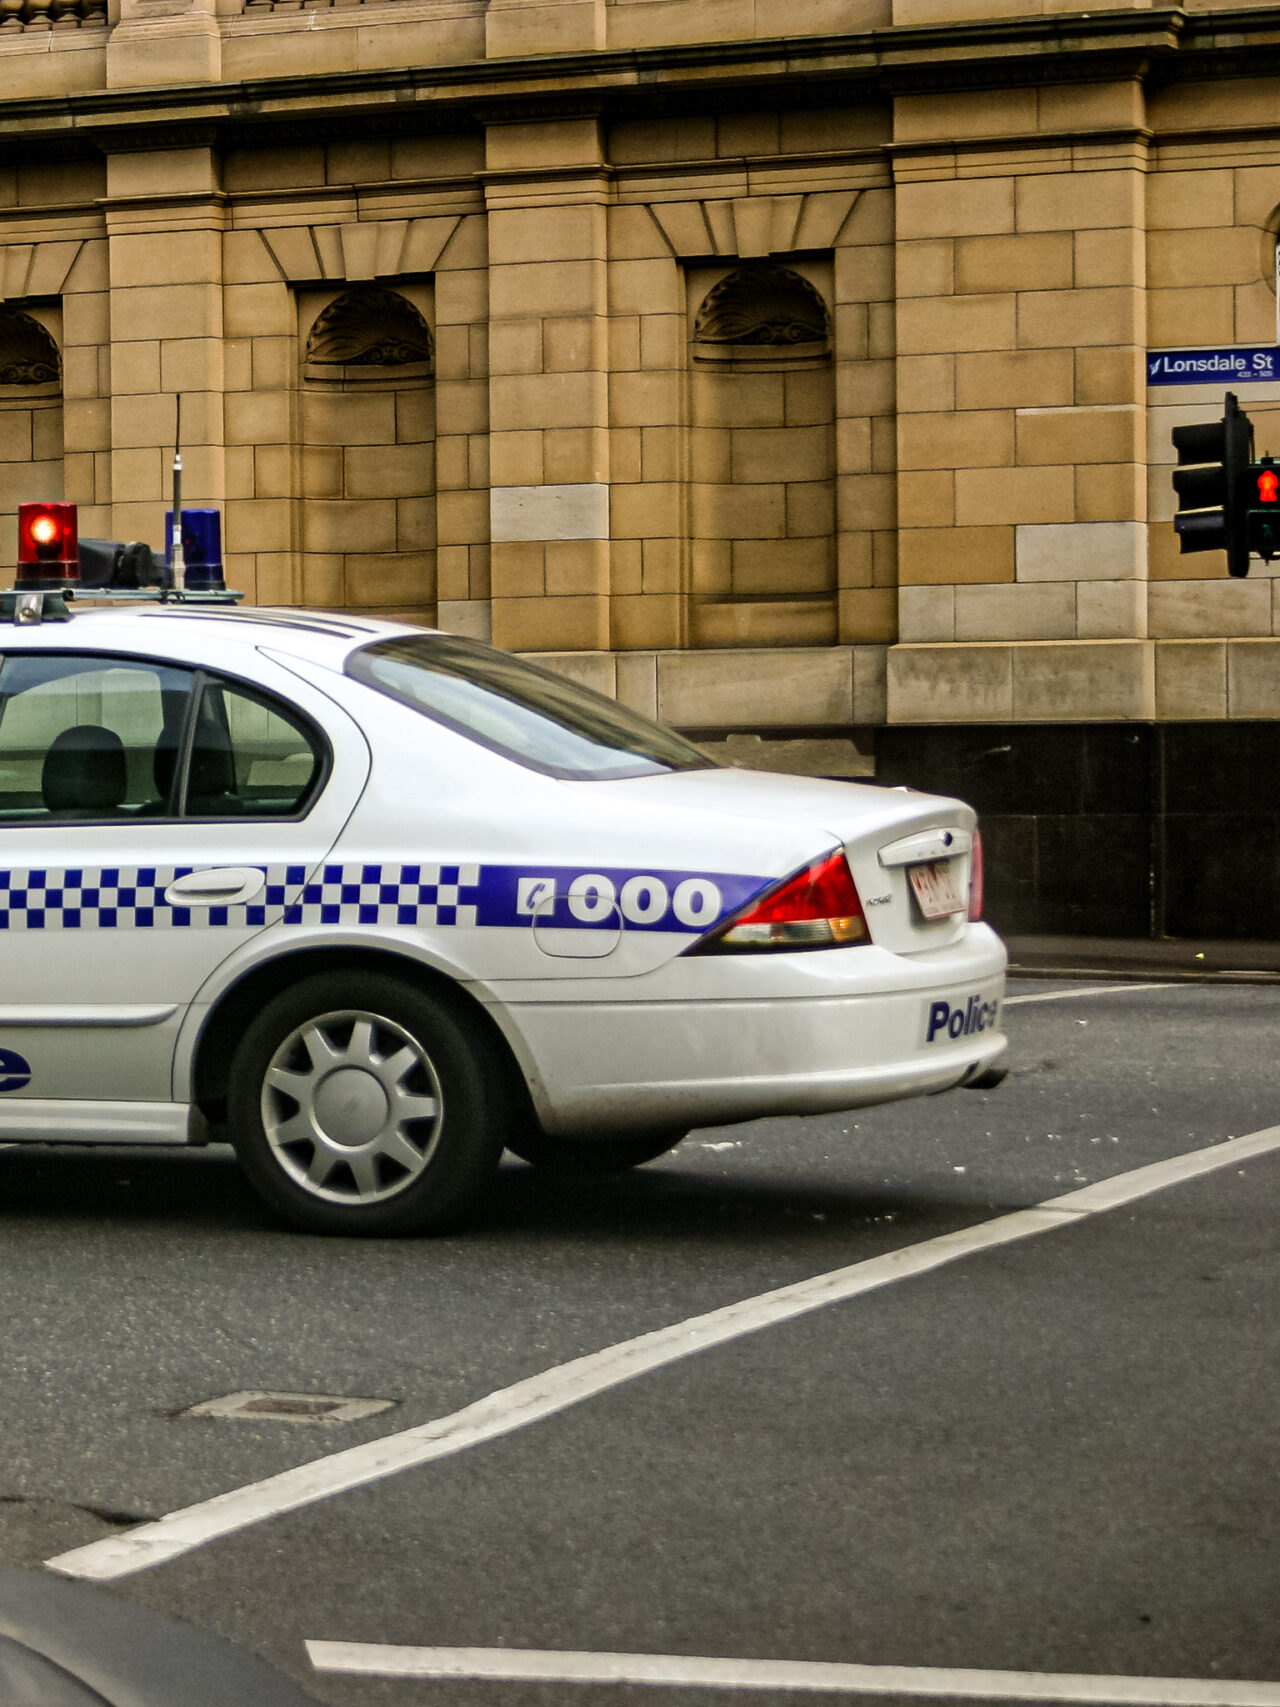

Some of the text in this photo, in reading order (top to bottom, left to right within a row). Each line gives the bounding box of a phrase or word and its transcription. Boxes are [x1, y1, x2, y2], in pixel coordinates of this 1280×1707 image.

[1163, 353, 1273, 372] Lonsdale St
[568, 873, 723, 927] 000
[926, 994, 998, 1043] Police
